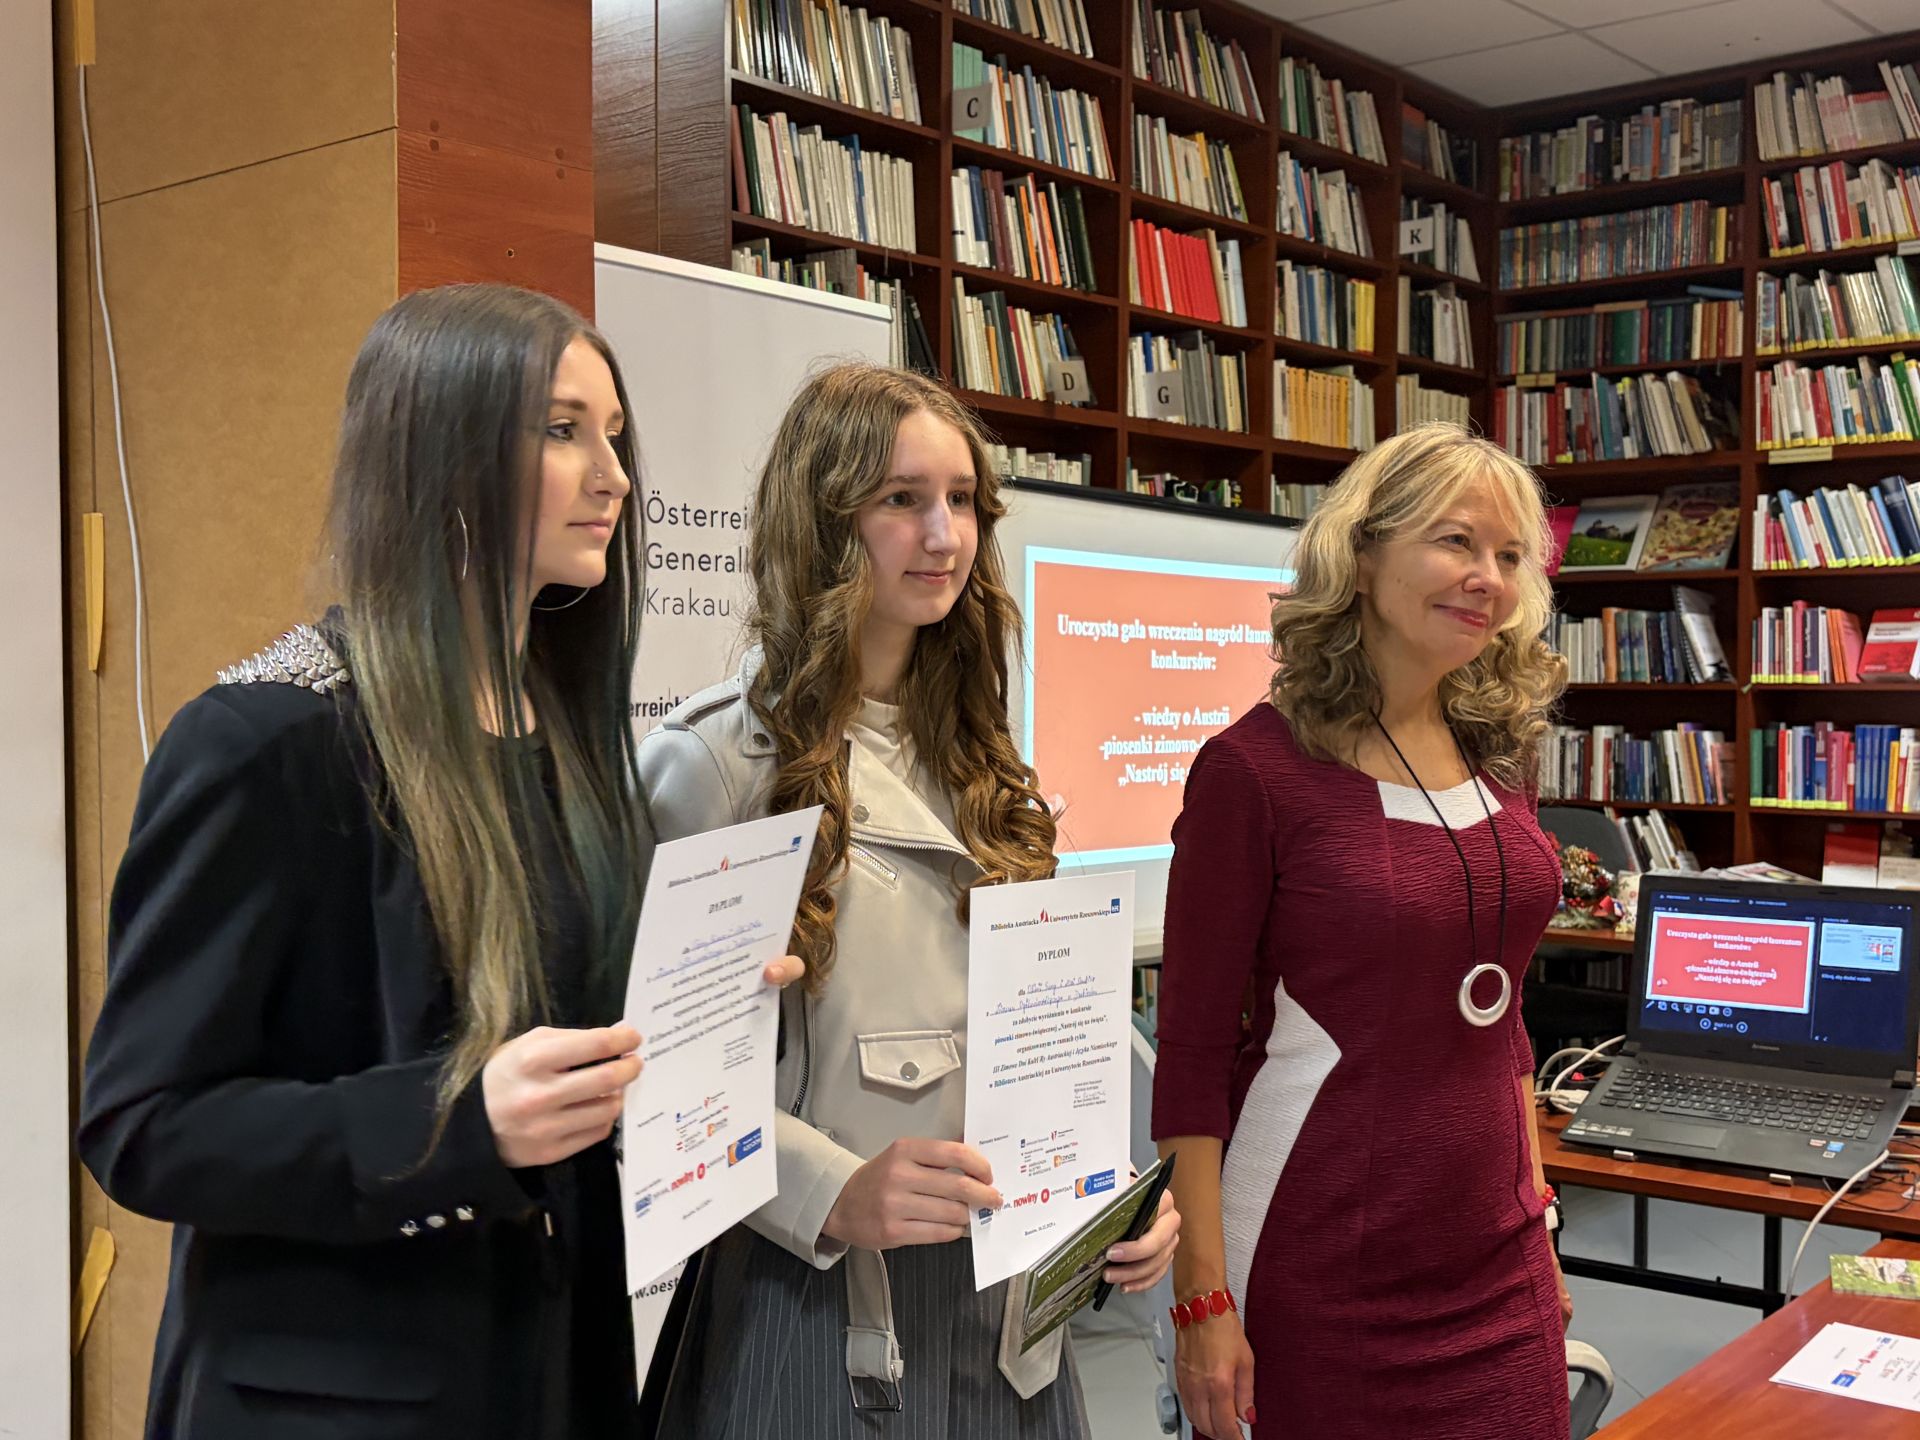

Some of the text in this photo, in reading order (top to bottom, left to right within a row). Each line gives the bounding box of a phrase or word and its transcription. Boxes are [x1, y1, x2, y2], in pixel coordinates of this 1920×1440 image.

[967, 97, 978, 118] C
[1410, 228, 1422, 245] K
[1061, 372, 1075, 391] D
[1157, 386, 1170, 404] G
[646, 490, 748, 530] Österrei
[645, 587, 731, 617] Krakau
[1057, 613, 1119, 642] Uroczysta
[1121, 618, 1146, 643] gala
[1205, 624, 1244, 647] nagród
[1151, 649, 1217, 671] konkursów:
[1142, 705, 1181, 730] wiedzy
[1182, 711, 1191, 726] o
[1192, 705, 1230, 725] Austrii
[1099, 735, 1153, 760] -piosenki
[1170, 762, 1185, 785] się
[1038, 947, 1070, 961] DYPLOM
[1013, 1192, 1038, 1208] nowiny
